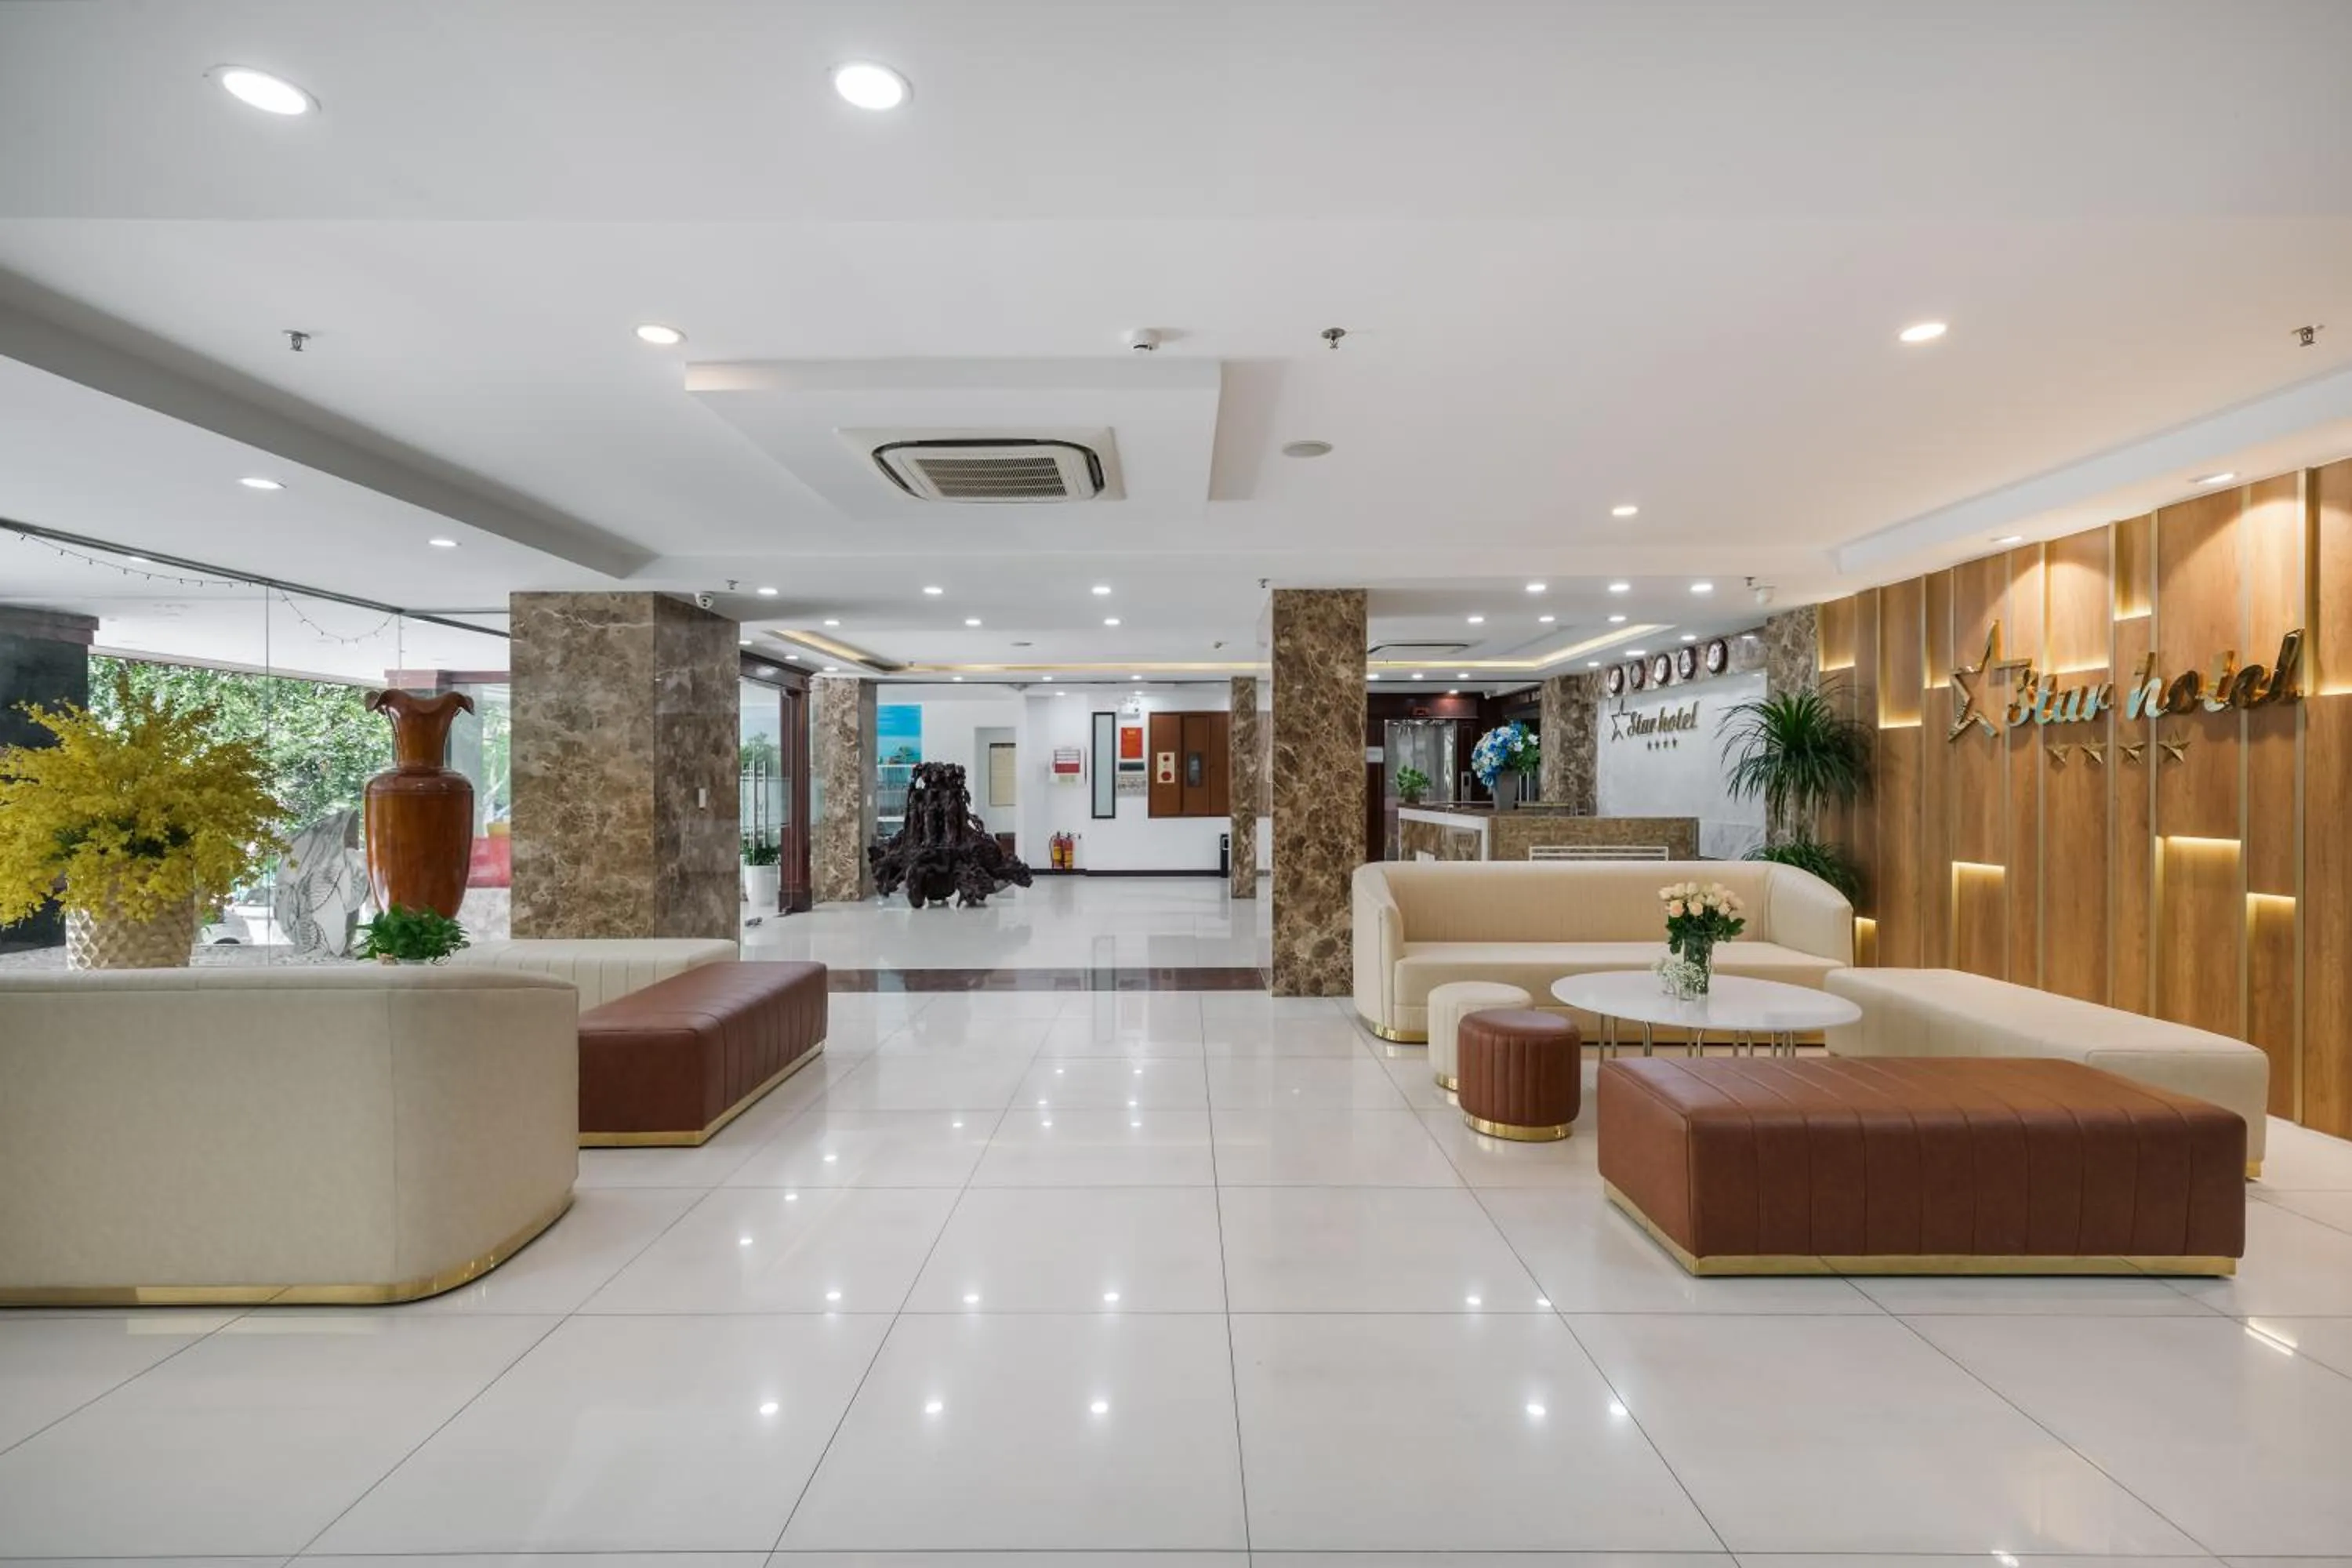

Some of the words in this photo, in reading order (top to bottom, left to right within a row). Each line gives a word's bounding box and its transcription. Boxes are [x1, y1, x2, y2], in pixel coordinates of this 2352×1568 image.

[2006, 667, 2114, 728] Star
[2126, 628, 2306, 721] hotel
[1627, 710, 1657, 736] Star
[1657, 701, 1700, 732] hotel
